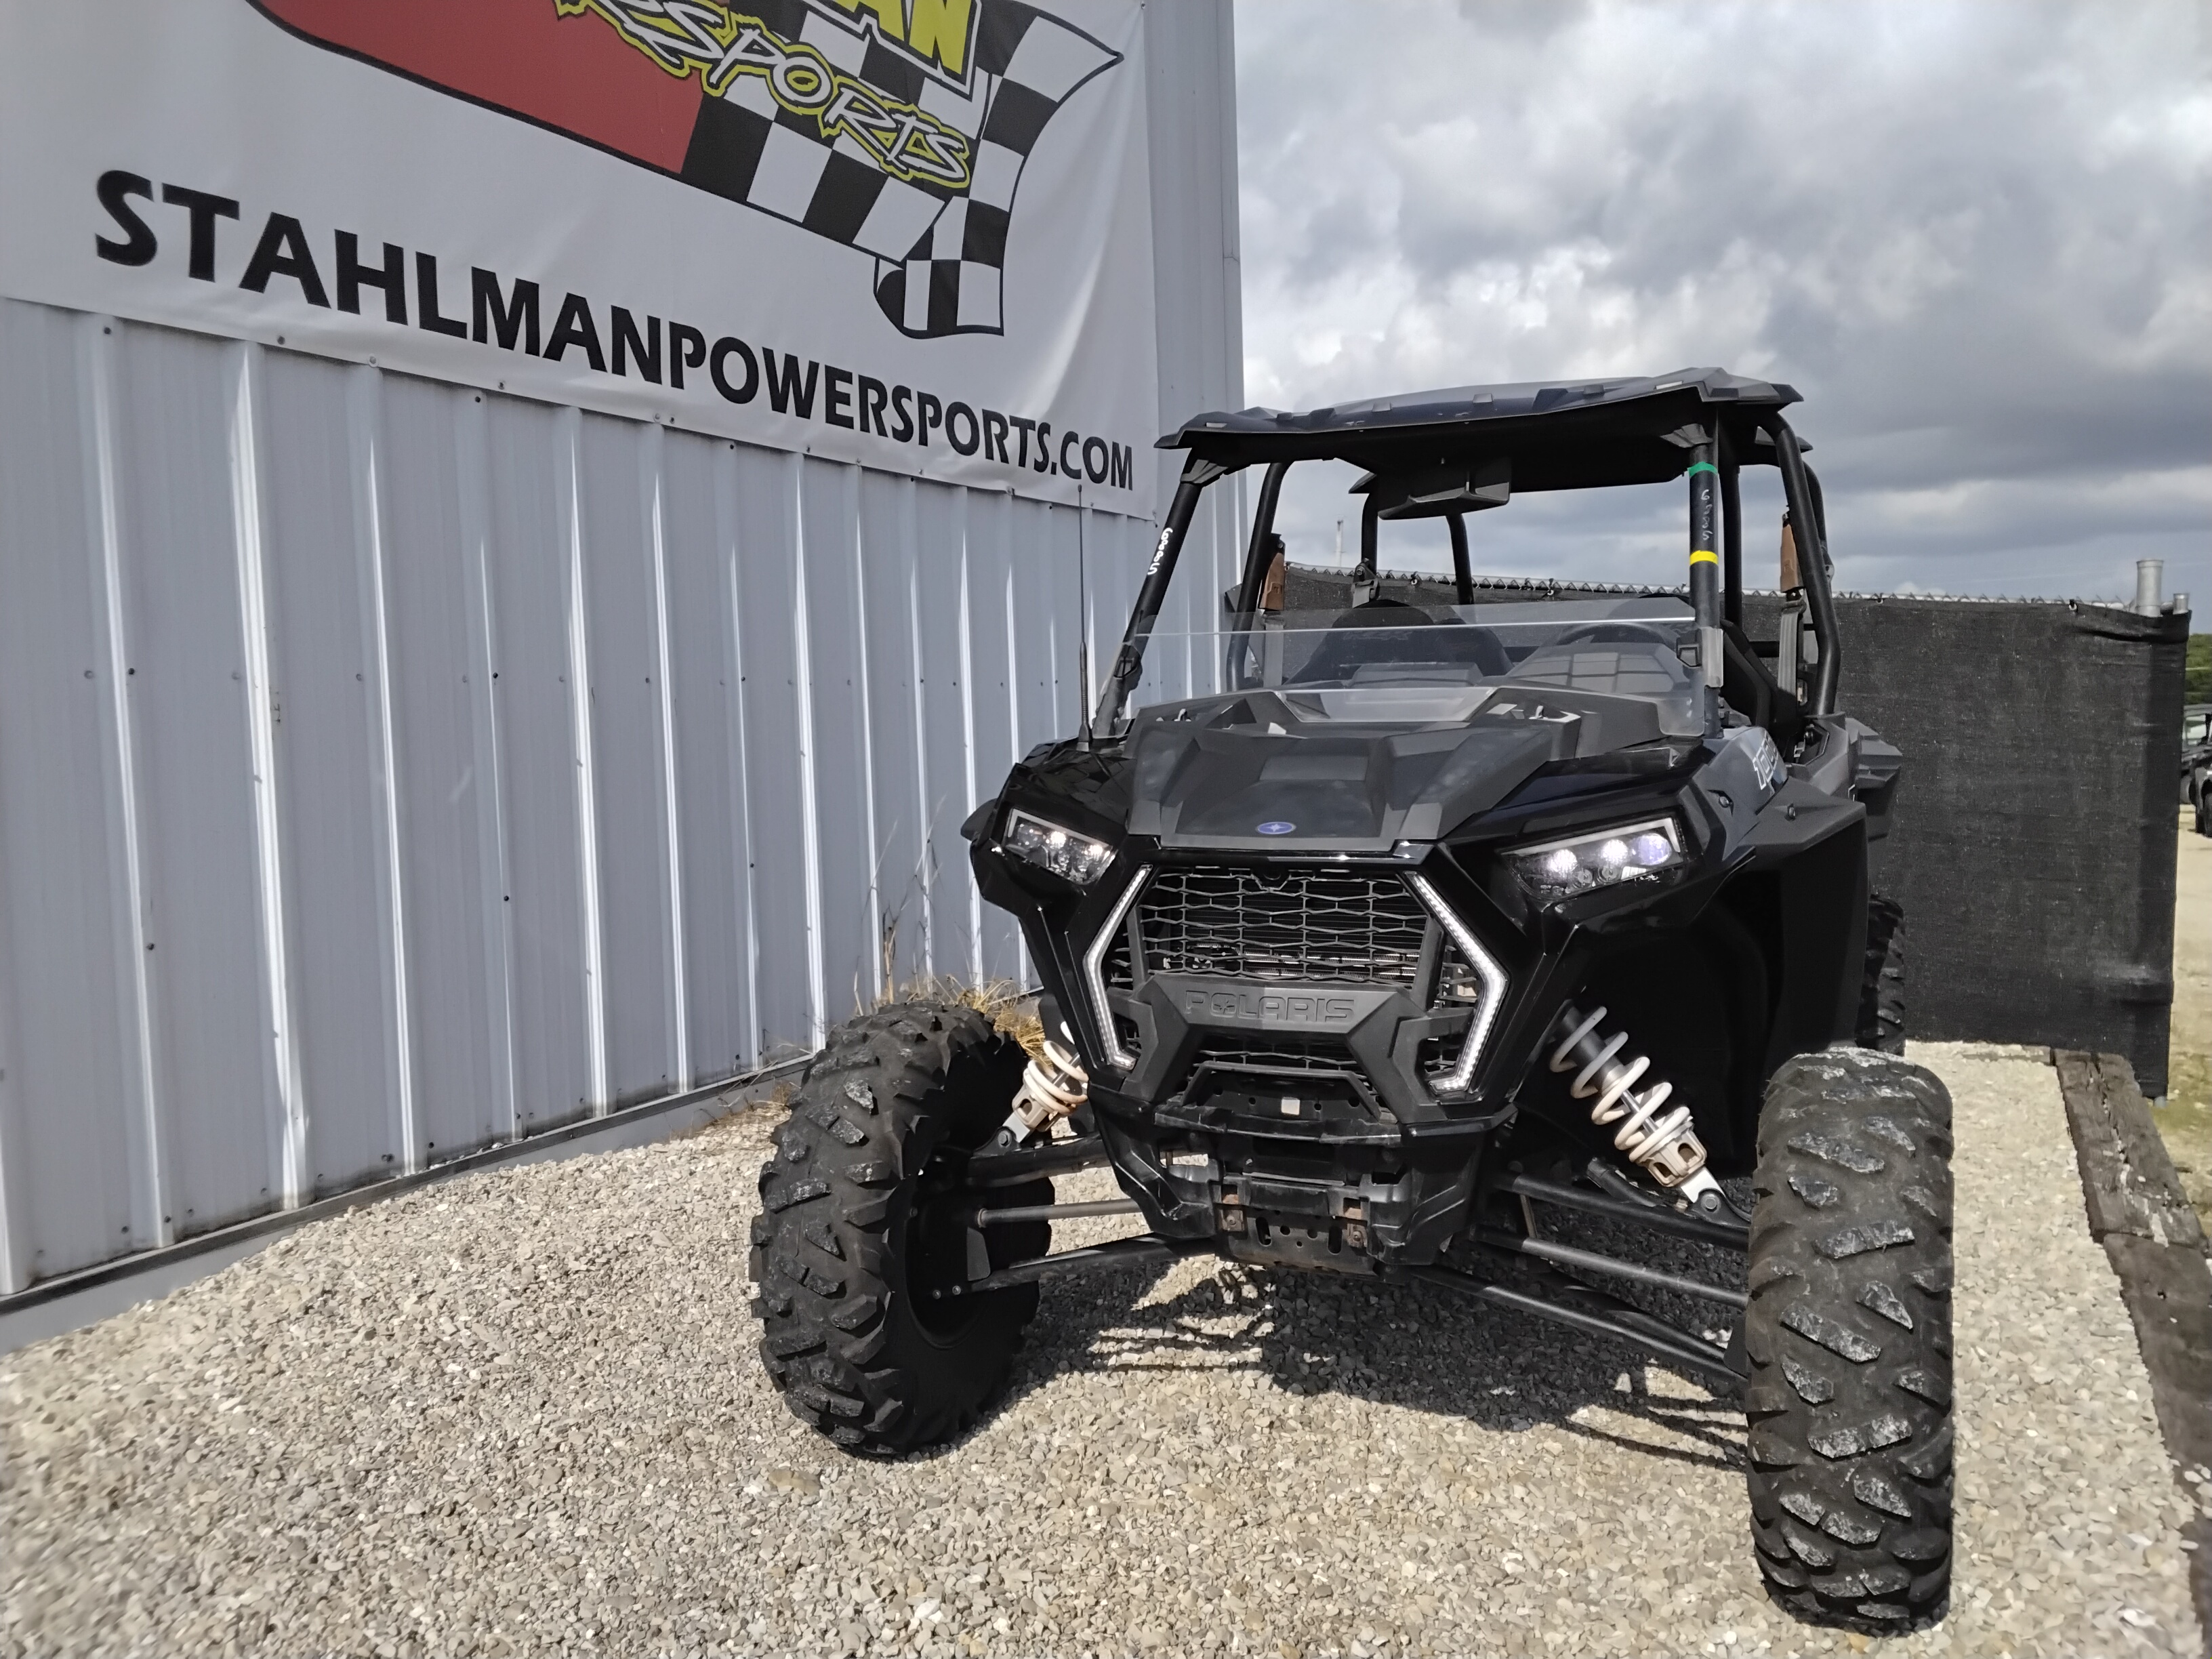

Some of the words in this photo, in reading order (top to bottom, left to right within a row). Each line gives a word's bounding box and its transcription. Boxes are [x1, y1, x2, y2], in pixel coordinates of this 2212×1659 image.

[95, 169, 1133, 491] STAHLMANPOWERSPORTS.COM
[1147, 527, 1173, 575] 6885
[1185, 989, 1355, 1023] POLARIS
